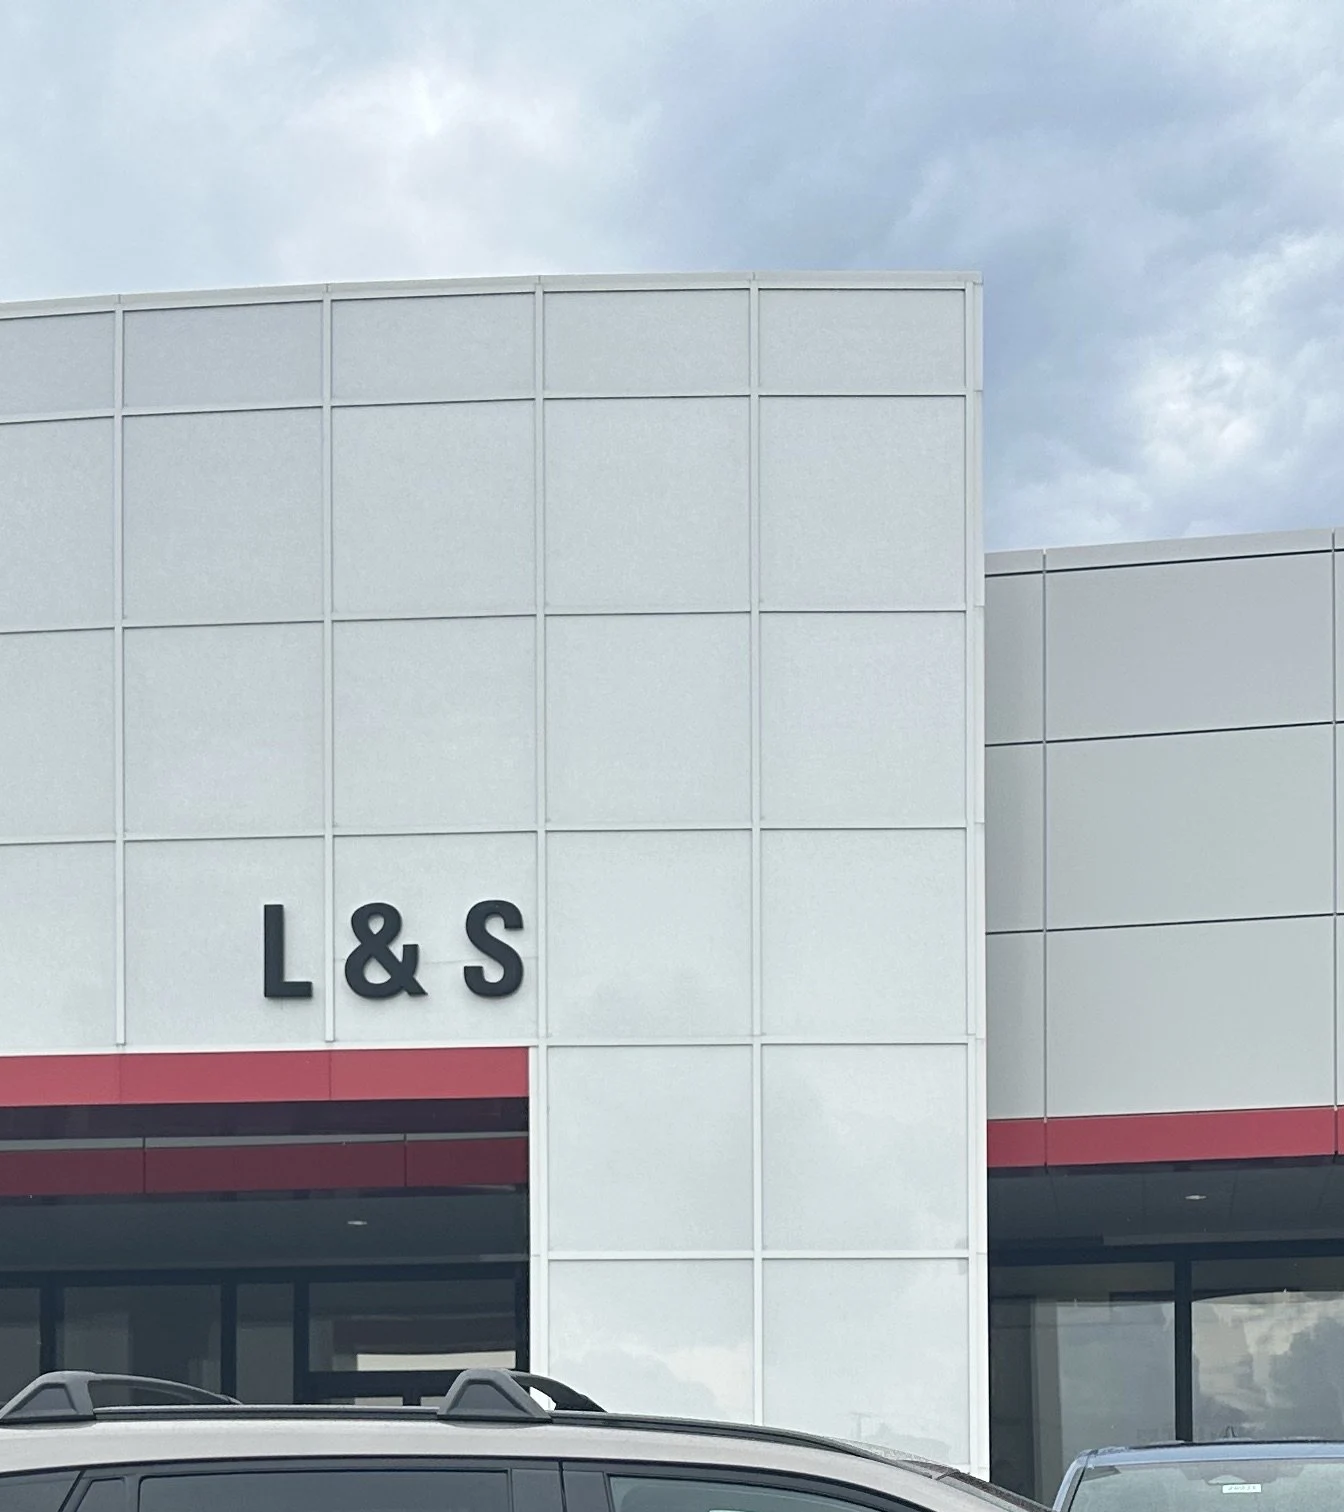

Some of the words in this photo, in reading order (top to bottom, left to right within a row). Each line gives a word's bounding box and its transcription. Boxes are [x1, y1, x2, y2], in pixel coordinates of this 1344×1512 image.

[264, 904, 312, 998] L
[344, 902, 427, 998] &
[463, 899, 524, 998] S
